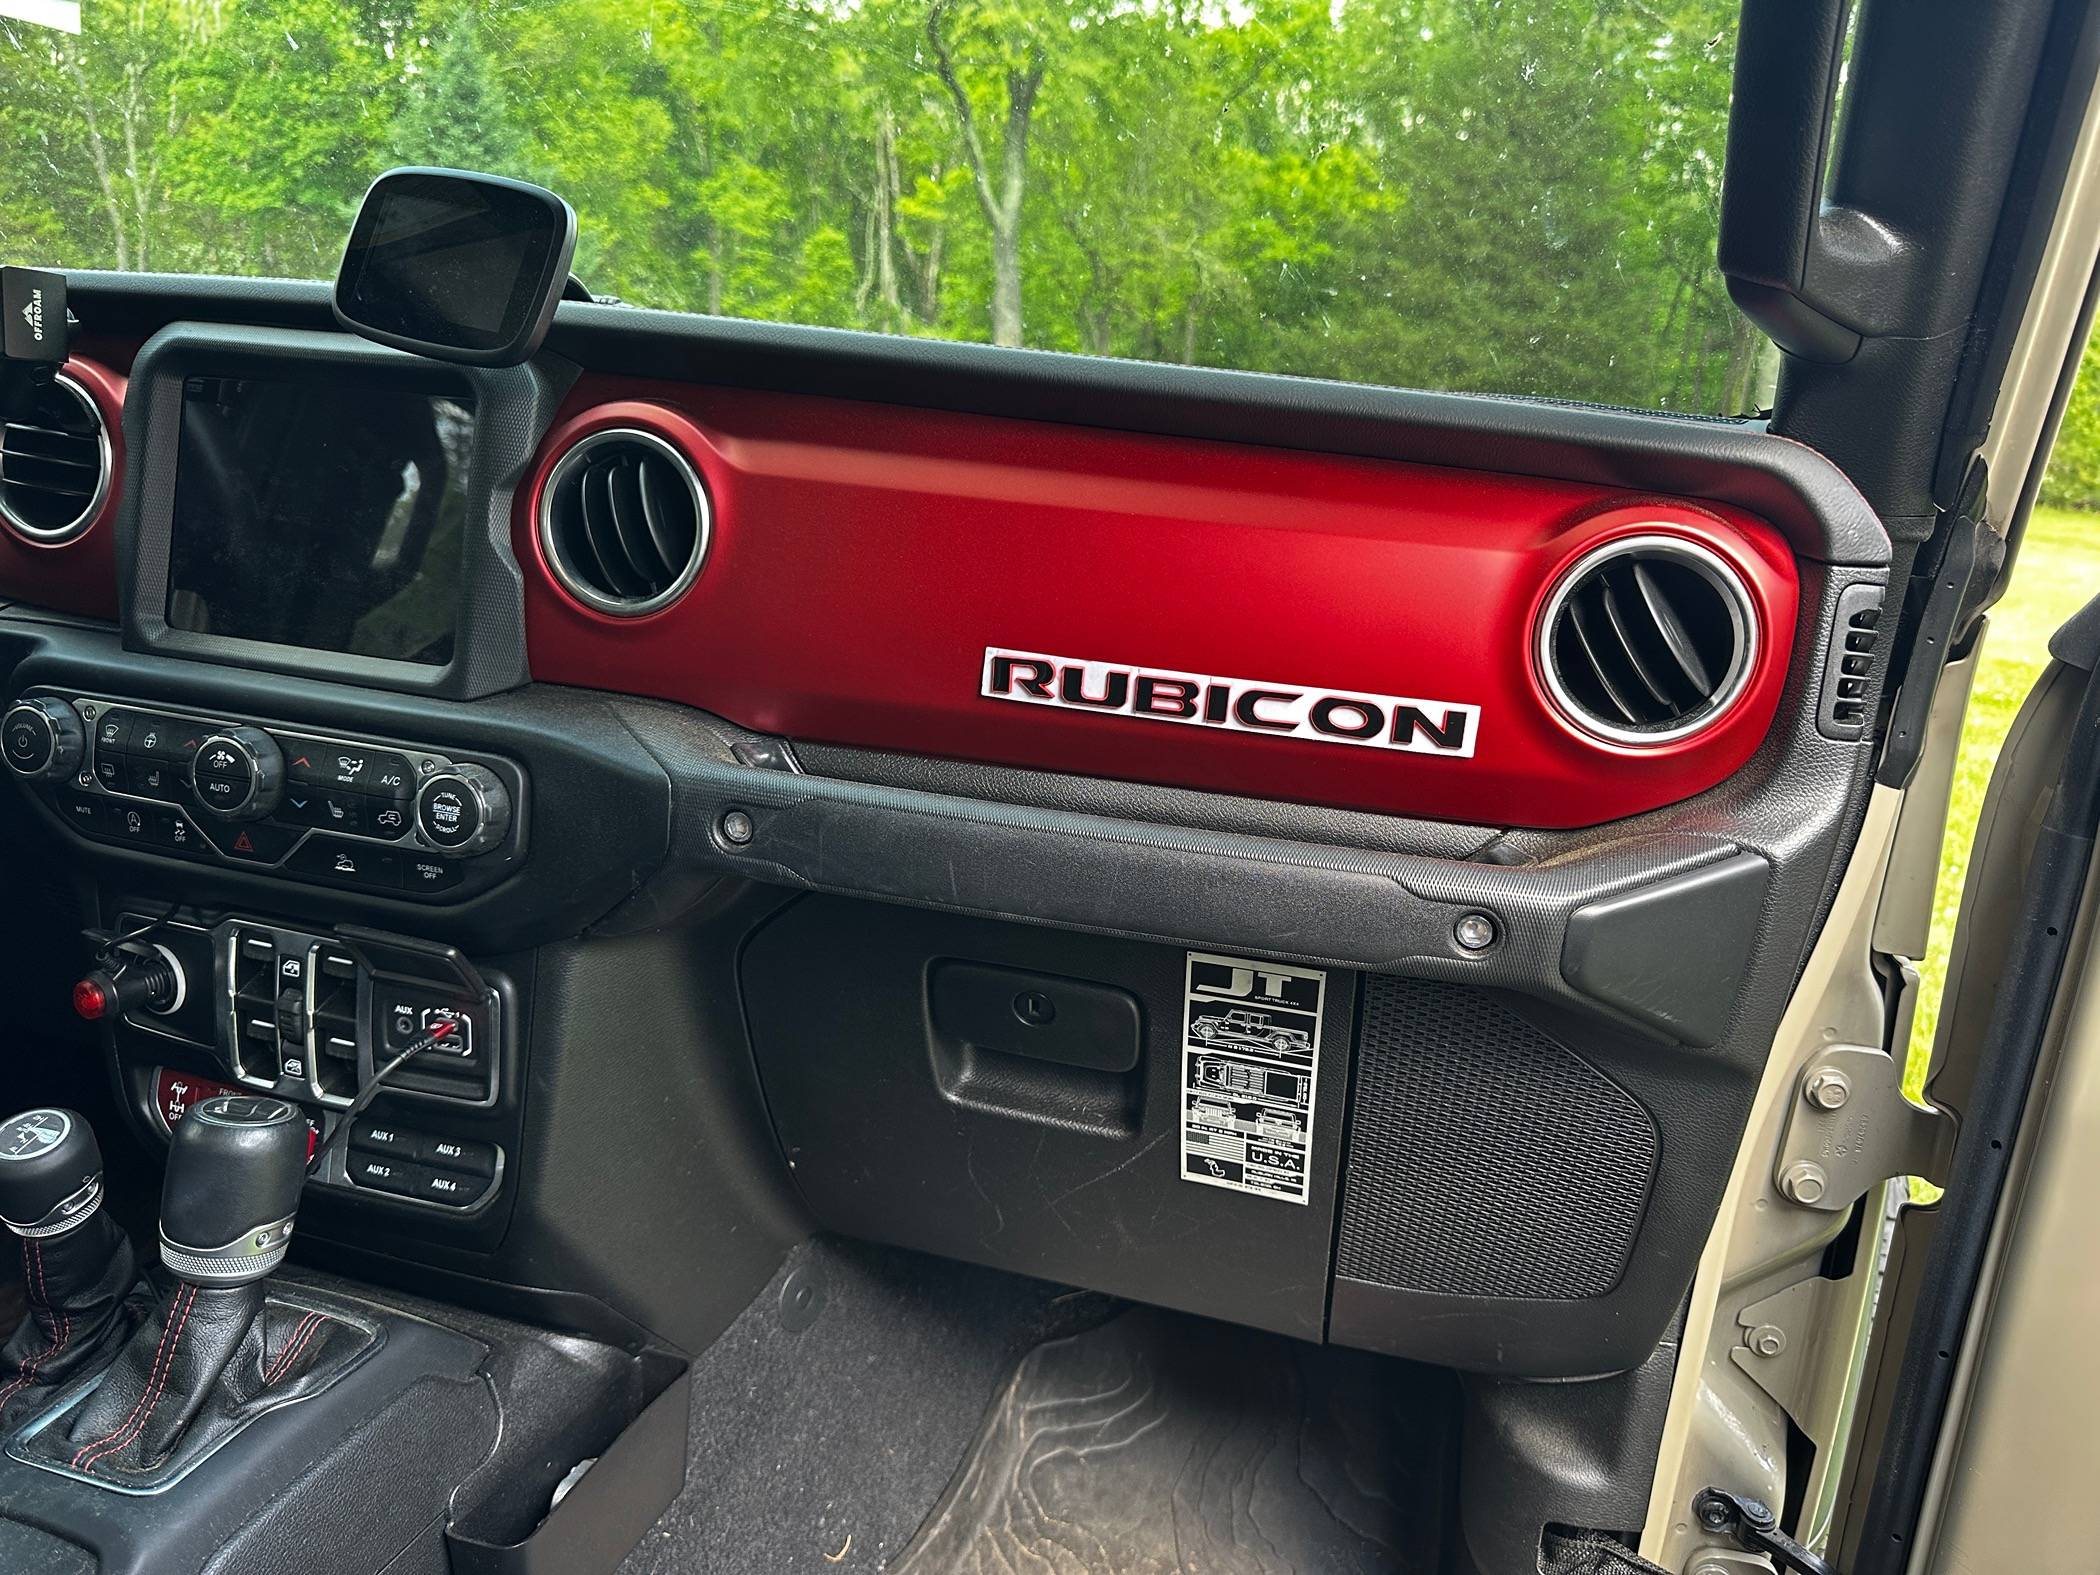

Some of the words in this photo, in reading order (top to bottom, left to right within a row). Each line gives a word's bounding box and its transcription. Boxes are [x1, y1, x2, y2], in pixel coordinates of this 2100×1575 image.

[33, 289, 43, 341] OFFROAM
[990, 655, 1465, 750] RUBICON
[213, 760, 228, 769] OFF
[337, 775, 354, 783] MODE
[380, 775, 401, 786] A/C
[209, 783, 231, 793] AUTO
[440, 792, 457, 801] TUNE
[75, 805, 92, 815] MUTE
[433, 802, 461, 812] BROWSE
[436, 812, 458, 822] ENTER
[129, 825, 141, 833] OFF
[416, 863, 444, 874] SCREEN
[423, 871, 437, 879] OFF
[1196, 968, 1292, 997] JT
[394, 1004, 414, 1015] AUX
[370, 1129, 389, 1141] AUX
[388, 1133, 395, 1142] 1
[435, 1143, 455, 1156] AUX
[453, 1146, 462, 1157] 3
[1251, 1151, 1301, 1171] U.S.A.
[366, 1164, 384, 1176] AUX
[383, 1167, 391, 1177] 2
[431, 1178, 450, 1191] AUX
[448, 1182, 457, 1192] 4
